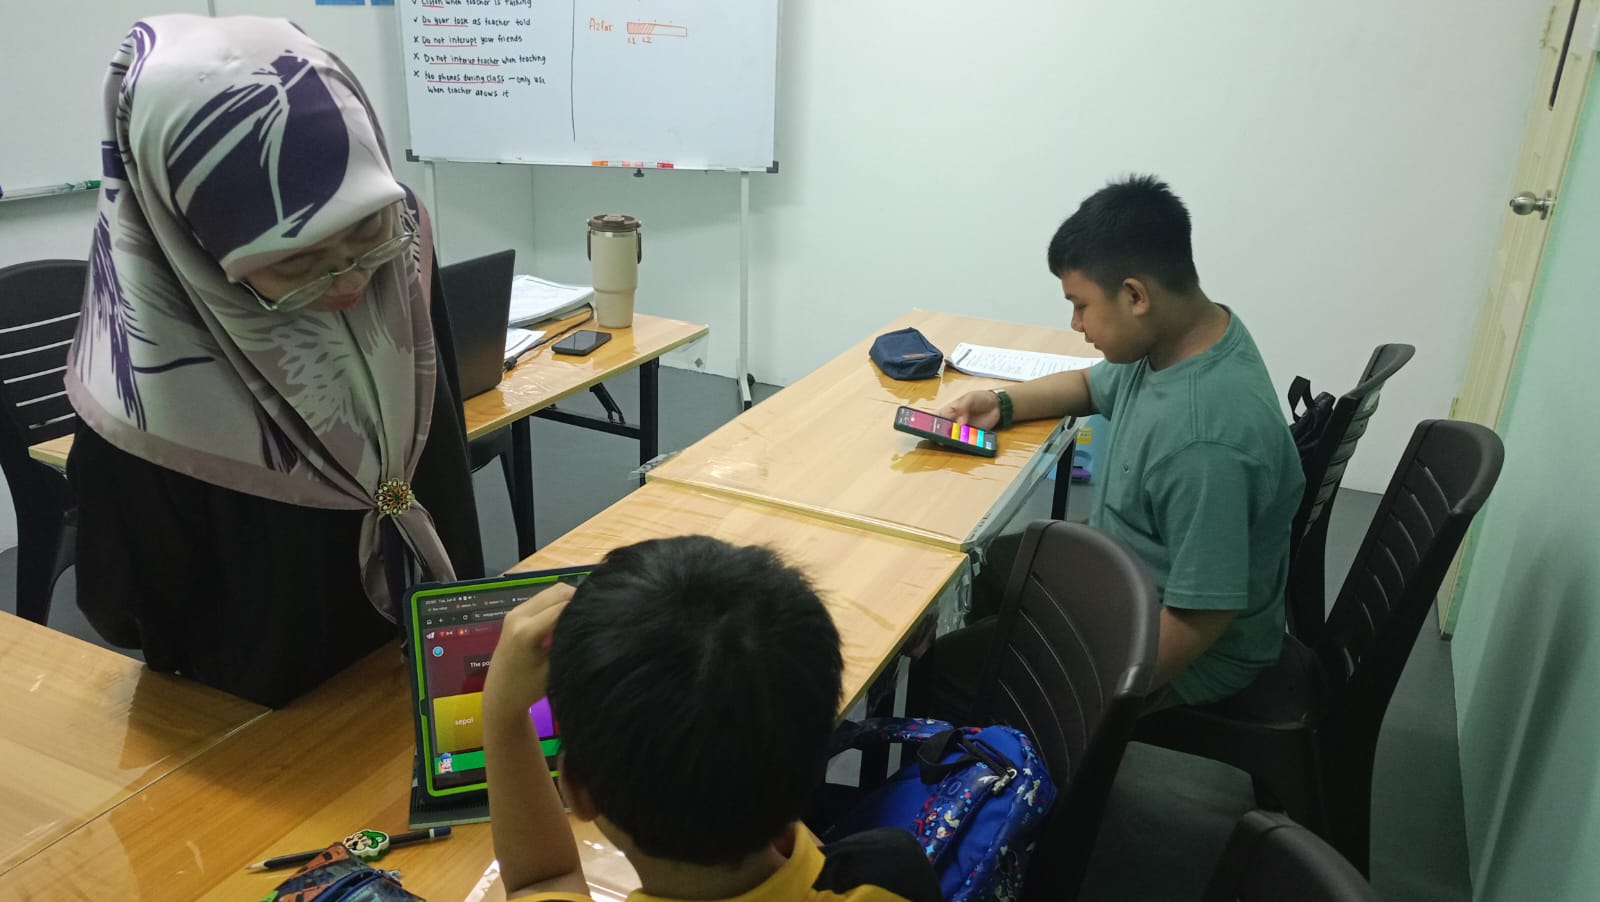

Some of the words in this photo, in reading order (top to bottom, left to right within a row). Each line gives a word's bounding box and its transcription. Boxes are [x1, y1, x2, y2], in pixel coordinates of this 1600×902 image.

[422, 16, 431, 24] Do
[434, 17, 450, 25] your
[454, 16, 468, 24] task
[472, 18, 481, 26] as
[485, 18, 510, 26] teacher
[516, 18, 530, 26] told
[422, 36, 430, 44] Do
[480, 36, 494, 44] your
[498, 34, 522, 43] friends
[424, 54, 434, 62] Do
[436, 54, 447, 62] not
[477, 56, 500, 65] teacher
[502, 56, 516, 64] when
[519, 53, 546, 65] teaching
[425, 70, 435, 80] No
[438, 73, 460, 82] phones
[464, 74, 485, 84] during
[487, 74, 505, 82] class
[516, 76, 530, 85] only
[534, 76, 546, 84] use
[448, 86, 472, 95] teacher
